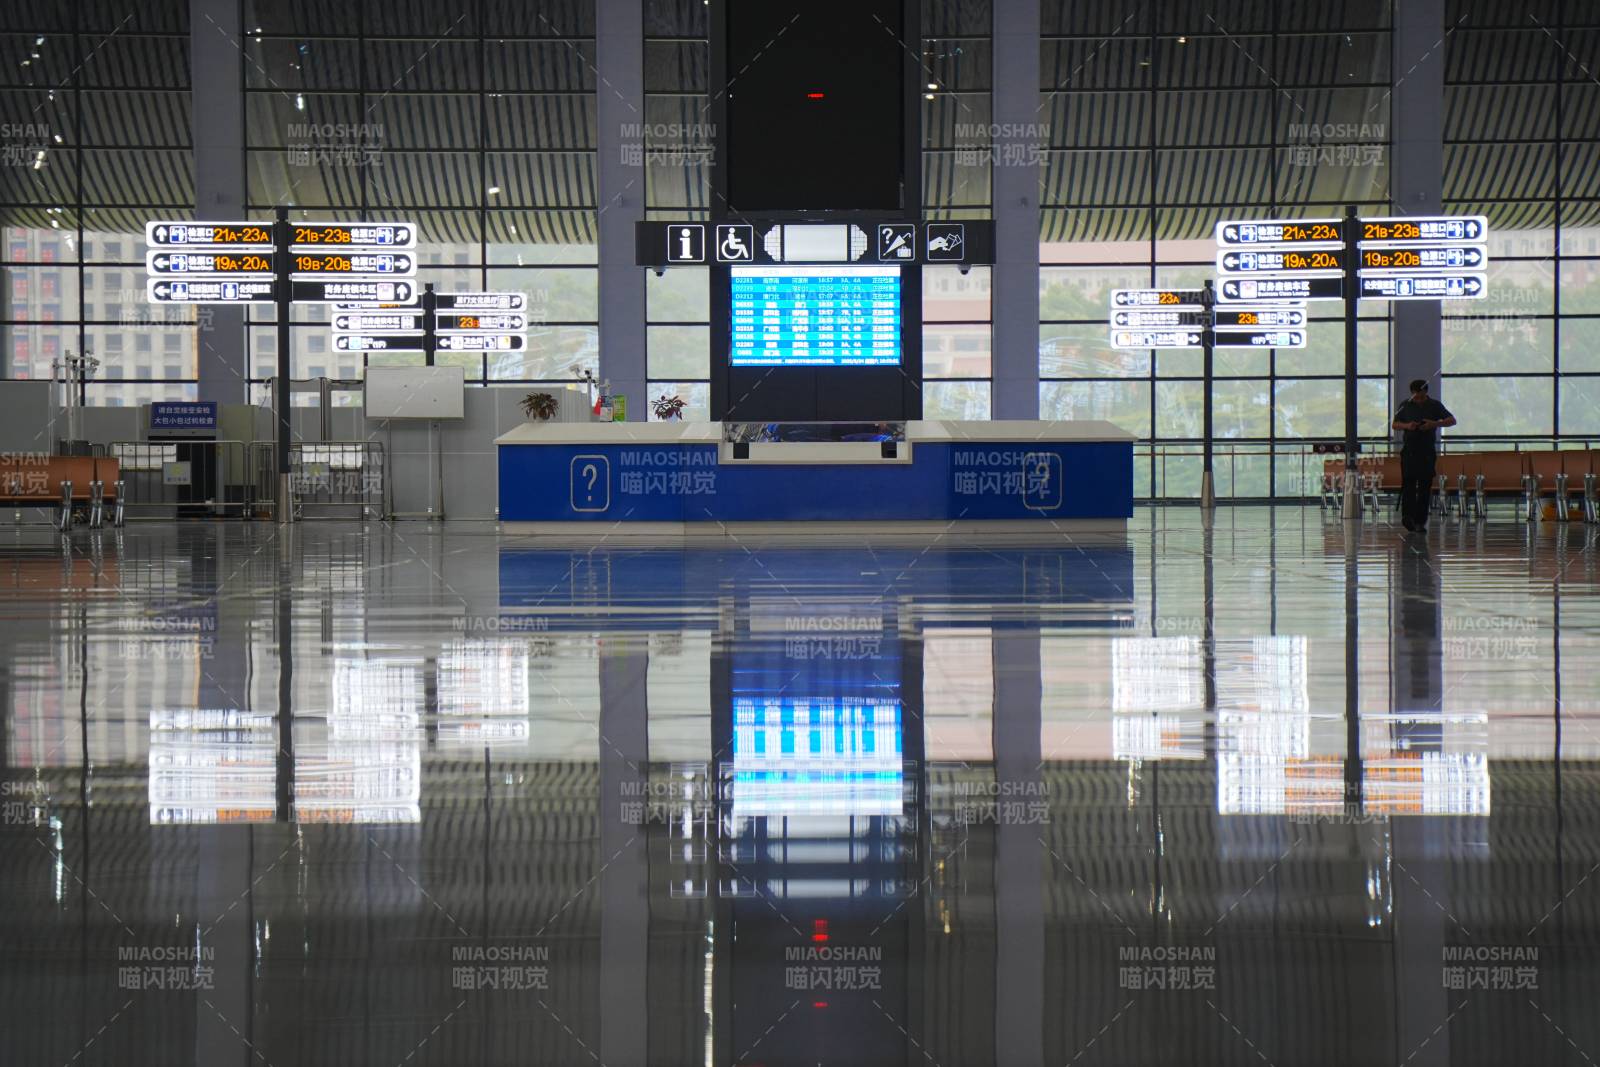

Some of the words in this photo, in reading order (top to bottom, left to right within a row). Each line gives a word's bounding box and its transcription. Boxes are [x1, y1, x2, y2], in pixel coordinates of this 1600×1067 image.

[214, 228, 268, 241] 21A-23A
[296, 229, 350, 242] 21B-23B
[1284, 226, 1338, 239] 21A-23A
[1365, 224, 1420, 238] 21B-23B
[1159, 293, 1179, 304] 23A
[1239, 313, 1258, 324] 23B
